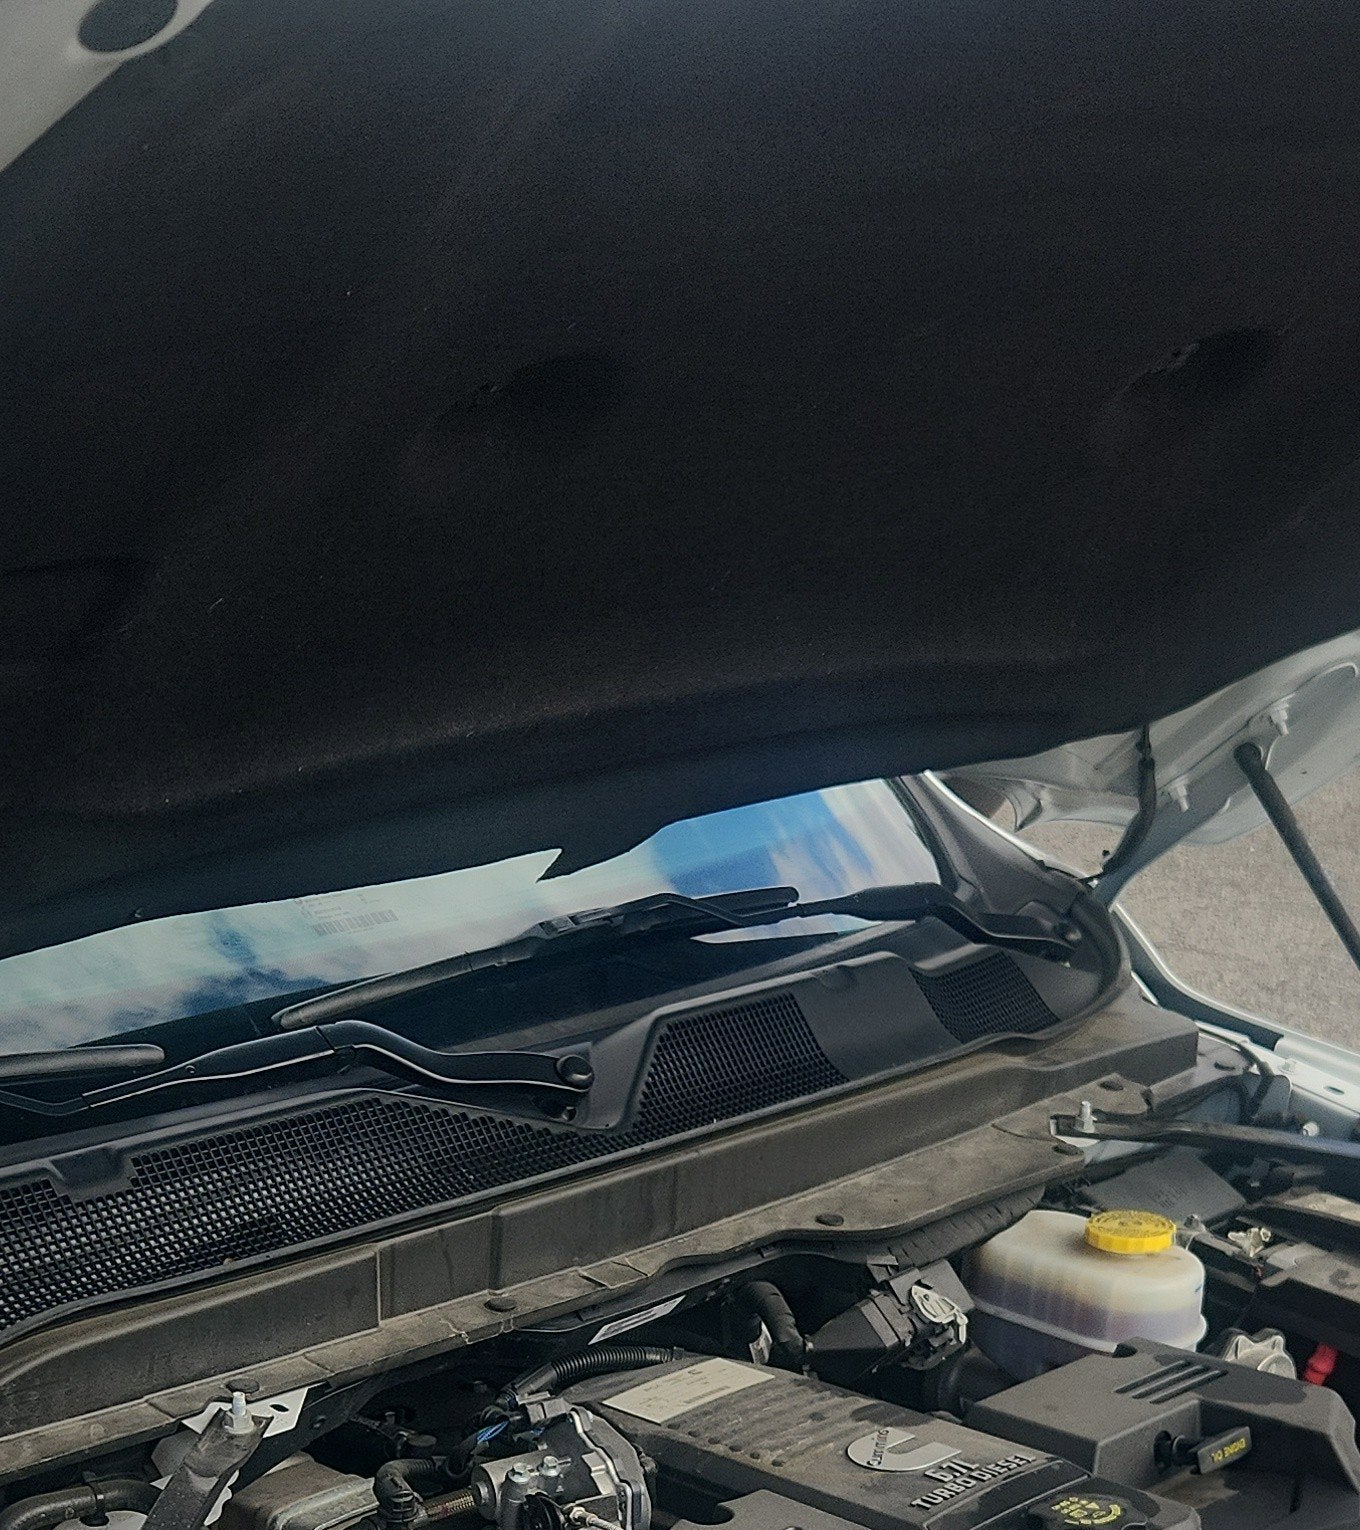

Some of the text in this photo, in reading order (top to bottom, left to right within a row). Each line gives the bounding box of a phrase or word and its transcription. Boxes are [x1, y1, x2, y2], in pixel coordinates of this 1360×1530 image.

[910, 1453, 1037, 1510] TURBO DIESEL
[924, 1458, 980, 1483] 6.7L
